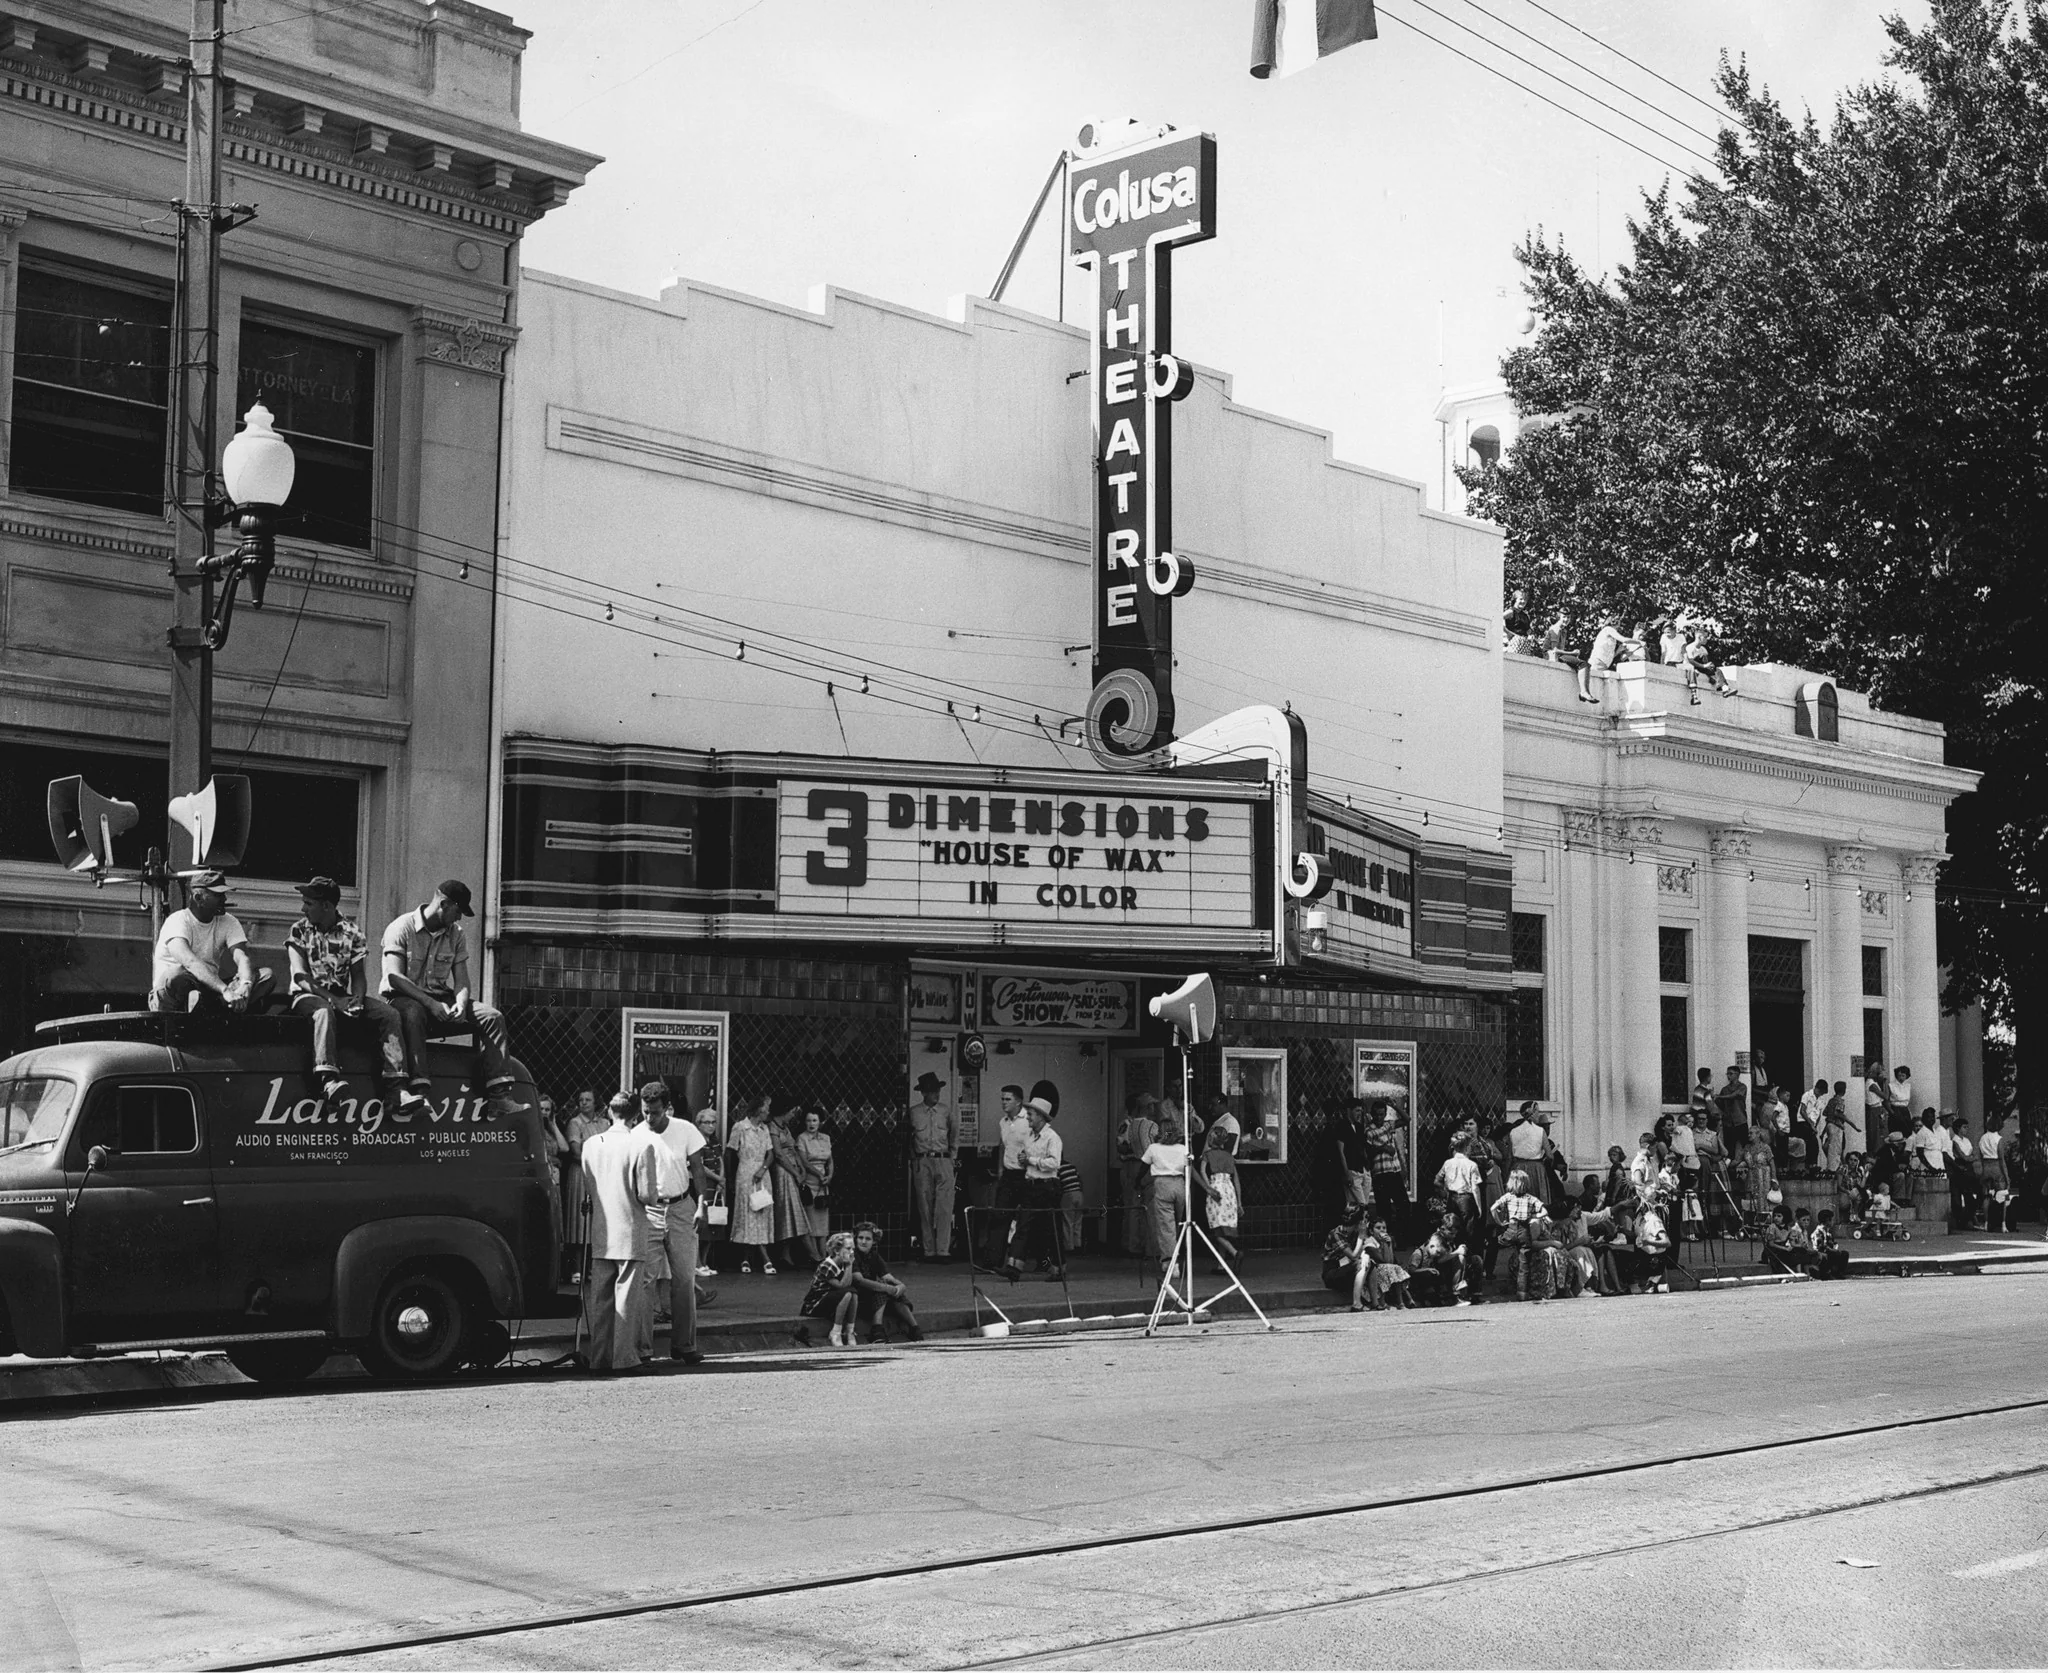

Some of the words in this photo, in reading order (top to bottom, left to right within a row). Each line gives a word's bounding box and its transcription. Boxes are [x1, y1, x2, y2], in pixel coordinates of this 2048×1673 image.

[1074, 166, 1196, 234] Colusa
[1105, 248, 1141, 628] THEATRE
[806, 788, 868, 887] 3
[888, 793, 1210, 842] DIMENSIONS
[1048, 844, 1084, 870] OF
[969, 880, 998, 905] IN
[1036, 883, 1138, 910] COLOR
[963, 970, 976, 1031] NOW
[996, 981, 1073, 1010] Continuous
[668, 1024, 700, 1036] PLAYING
[235, 1134, 271, 1147] AUDIO
[276, 1134, 340, 1147] ENGINEERS
[352, 1132, 417, 1145] BROADCAST
[429, 1131, 467, 1144] PUBLIC
[470, 1131, 517, 1143] ADDRESS
[290, 1152, 306, 1161] SAN
[307, 1152, 349, 1160] FRANCISCO
[420, 1150, 436, 1158] LOS
[437, 1149, 471, 1158] ANGELES
